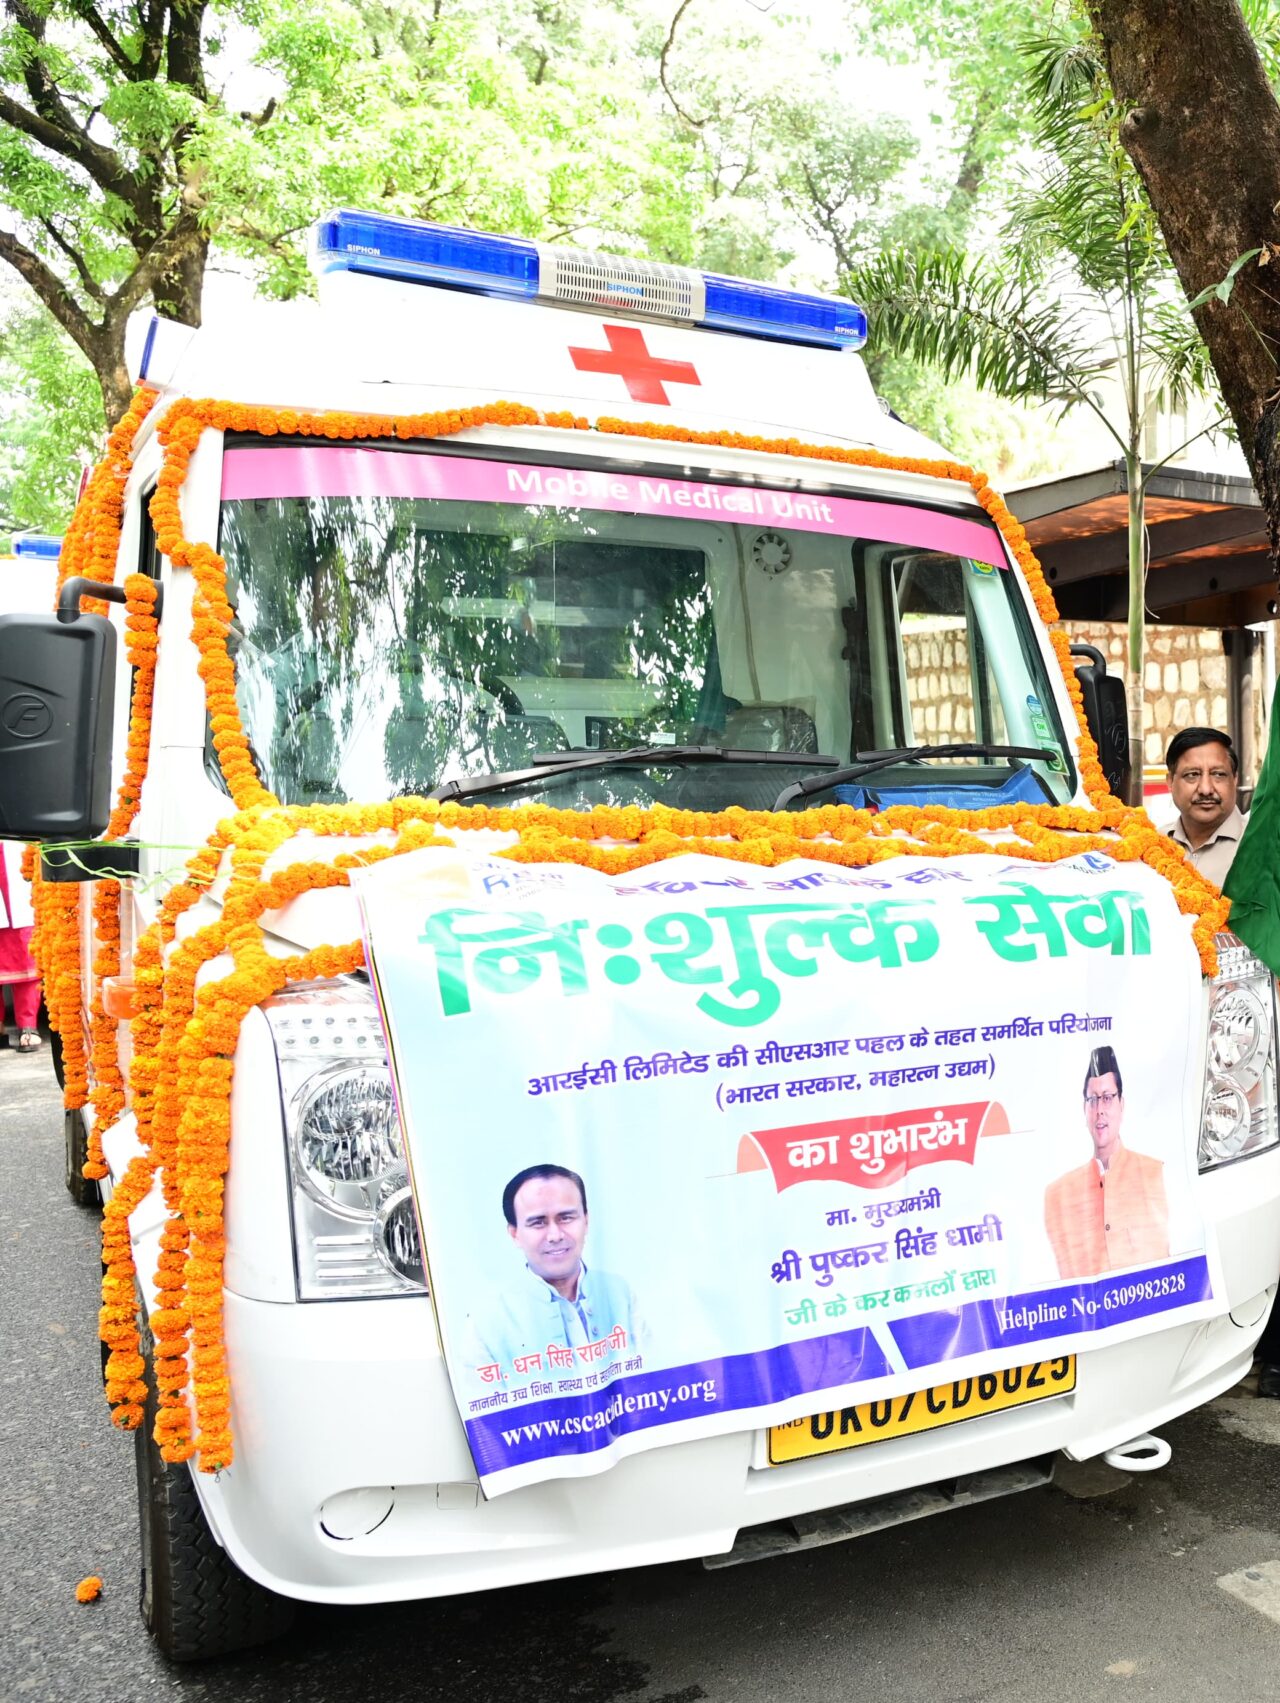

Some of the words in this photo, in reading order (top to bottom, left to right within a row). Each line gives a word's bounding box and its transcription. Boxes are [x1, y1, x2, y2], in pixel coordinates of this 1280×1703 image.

[347, 243, 381, 256] SIPHON
[607, 283, 644, 296] SIPHON
[506, 468, 630, 501] Mobile
[639, 480, 763, 515] Medical
[771, 494, 835, 523] Unit
[962, 881, 1152, 962] सेवा
[527, 1059, 618, 1097] आरईसी
[623, 1050, 710, 1082] लिमिटेड
[716, 1043, 750, 1069] की
[754, 1038, 851, 1067] सीएसआर
[855, 1033, 906, 1055] पहल
[908, 1026, 929, 1049] के
[934, 1027, 977, 1046] तहत
[981, 1016, 1044, 1042] समर्थित
[1048, 1012, 1113, 1035] परियोजना
[715, 1082, 780, 1113] (भारत
[785, 1072, 862, 1099] सरकार,
[869, 1063, 940, 1088] महारत्न
[944, 1053, 997, 1081] उद्यम)
[785, 1135, 840, 1169] का
[849, 1110, 969, 1175] शुभारंभ
[825, 1208, 858, 1227] मा.
[863, 1187, 942, 1228] मुख्यमंत्री
[770, 1249, 803, 1284] श्री
[808, 1241, 890, 1288] पुष्कर
[894, 1226, 939, 1260] सिंह
[944, 1213, 1004, 1248] धामी
[784, 1298, 818, 1326] जी
[822, 1293, 848, 1318] के
[960, 1268, 997, 1291] द्वारा
[1000, 1302, 1068, 1332] Helpline
[1103, 1272, 1187, 1311] 6309982828
[513, 1353, 543, 1374] धन
[546, 1343, 574, 1369] सिंह
[576, 1337, 608, 1363] रावत
[608, 1324, 628, 1351] जी
[468, 1390, 509, 1413] माननीय
[586, 1373, 598, 1389] एवं
[624, 1355, 644, 1371] मंत्री
[501, 1378, 717, 1447] www.cscacademy.org
